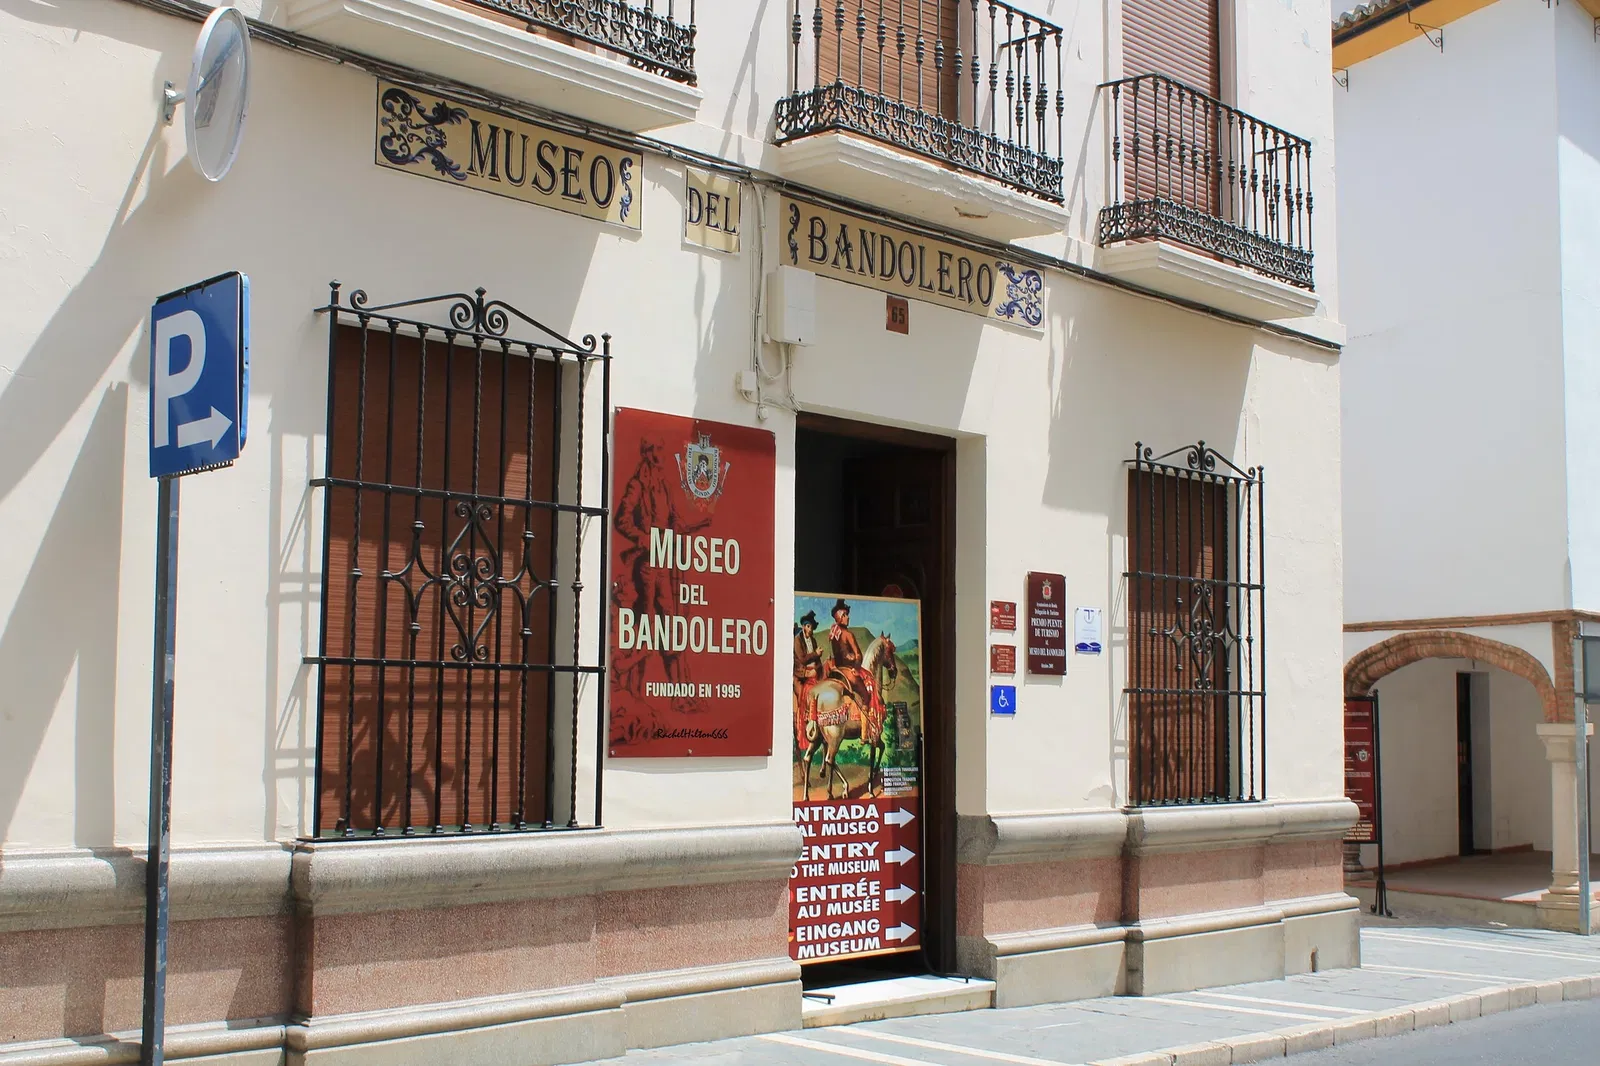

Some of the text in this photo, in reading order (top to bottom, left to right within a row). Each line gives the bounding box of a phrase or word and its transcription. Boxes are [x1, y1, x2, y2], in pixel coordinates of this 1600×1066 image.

[466, 118, 616, 209] MUSEO
[688, 186, 740, 235] DEL
[808, 216, 994, 306] BANDOLERO
[891, 306, 905, 325] 65
[154, 310, 207, 448] P
[679, 583, 708, 606] DEL
[618, 607, 768, 656] BANDOLERO
[645, 682, 741, 698] FUNDADO EN 1995
[794, 804, 879, 822] NTRADA
[797, 821, 879, 837] AL MUSEO
[790, 859, 880, 878] O THE MUSEUM
[796, 878, 880, 903] ENTRÉE
[797, 896, 880, 919] AU MUSÉE
[796, 918, 880, 942] EINGANG
[797, 936, 880, 959] MUSEUM
